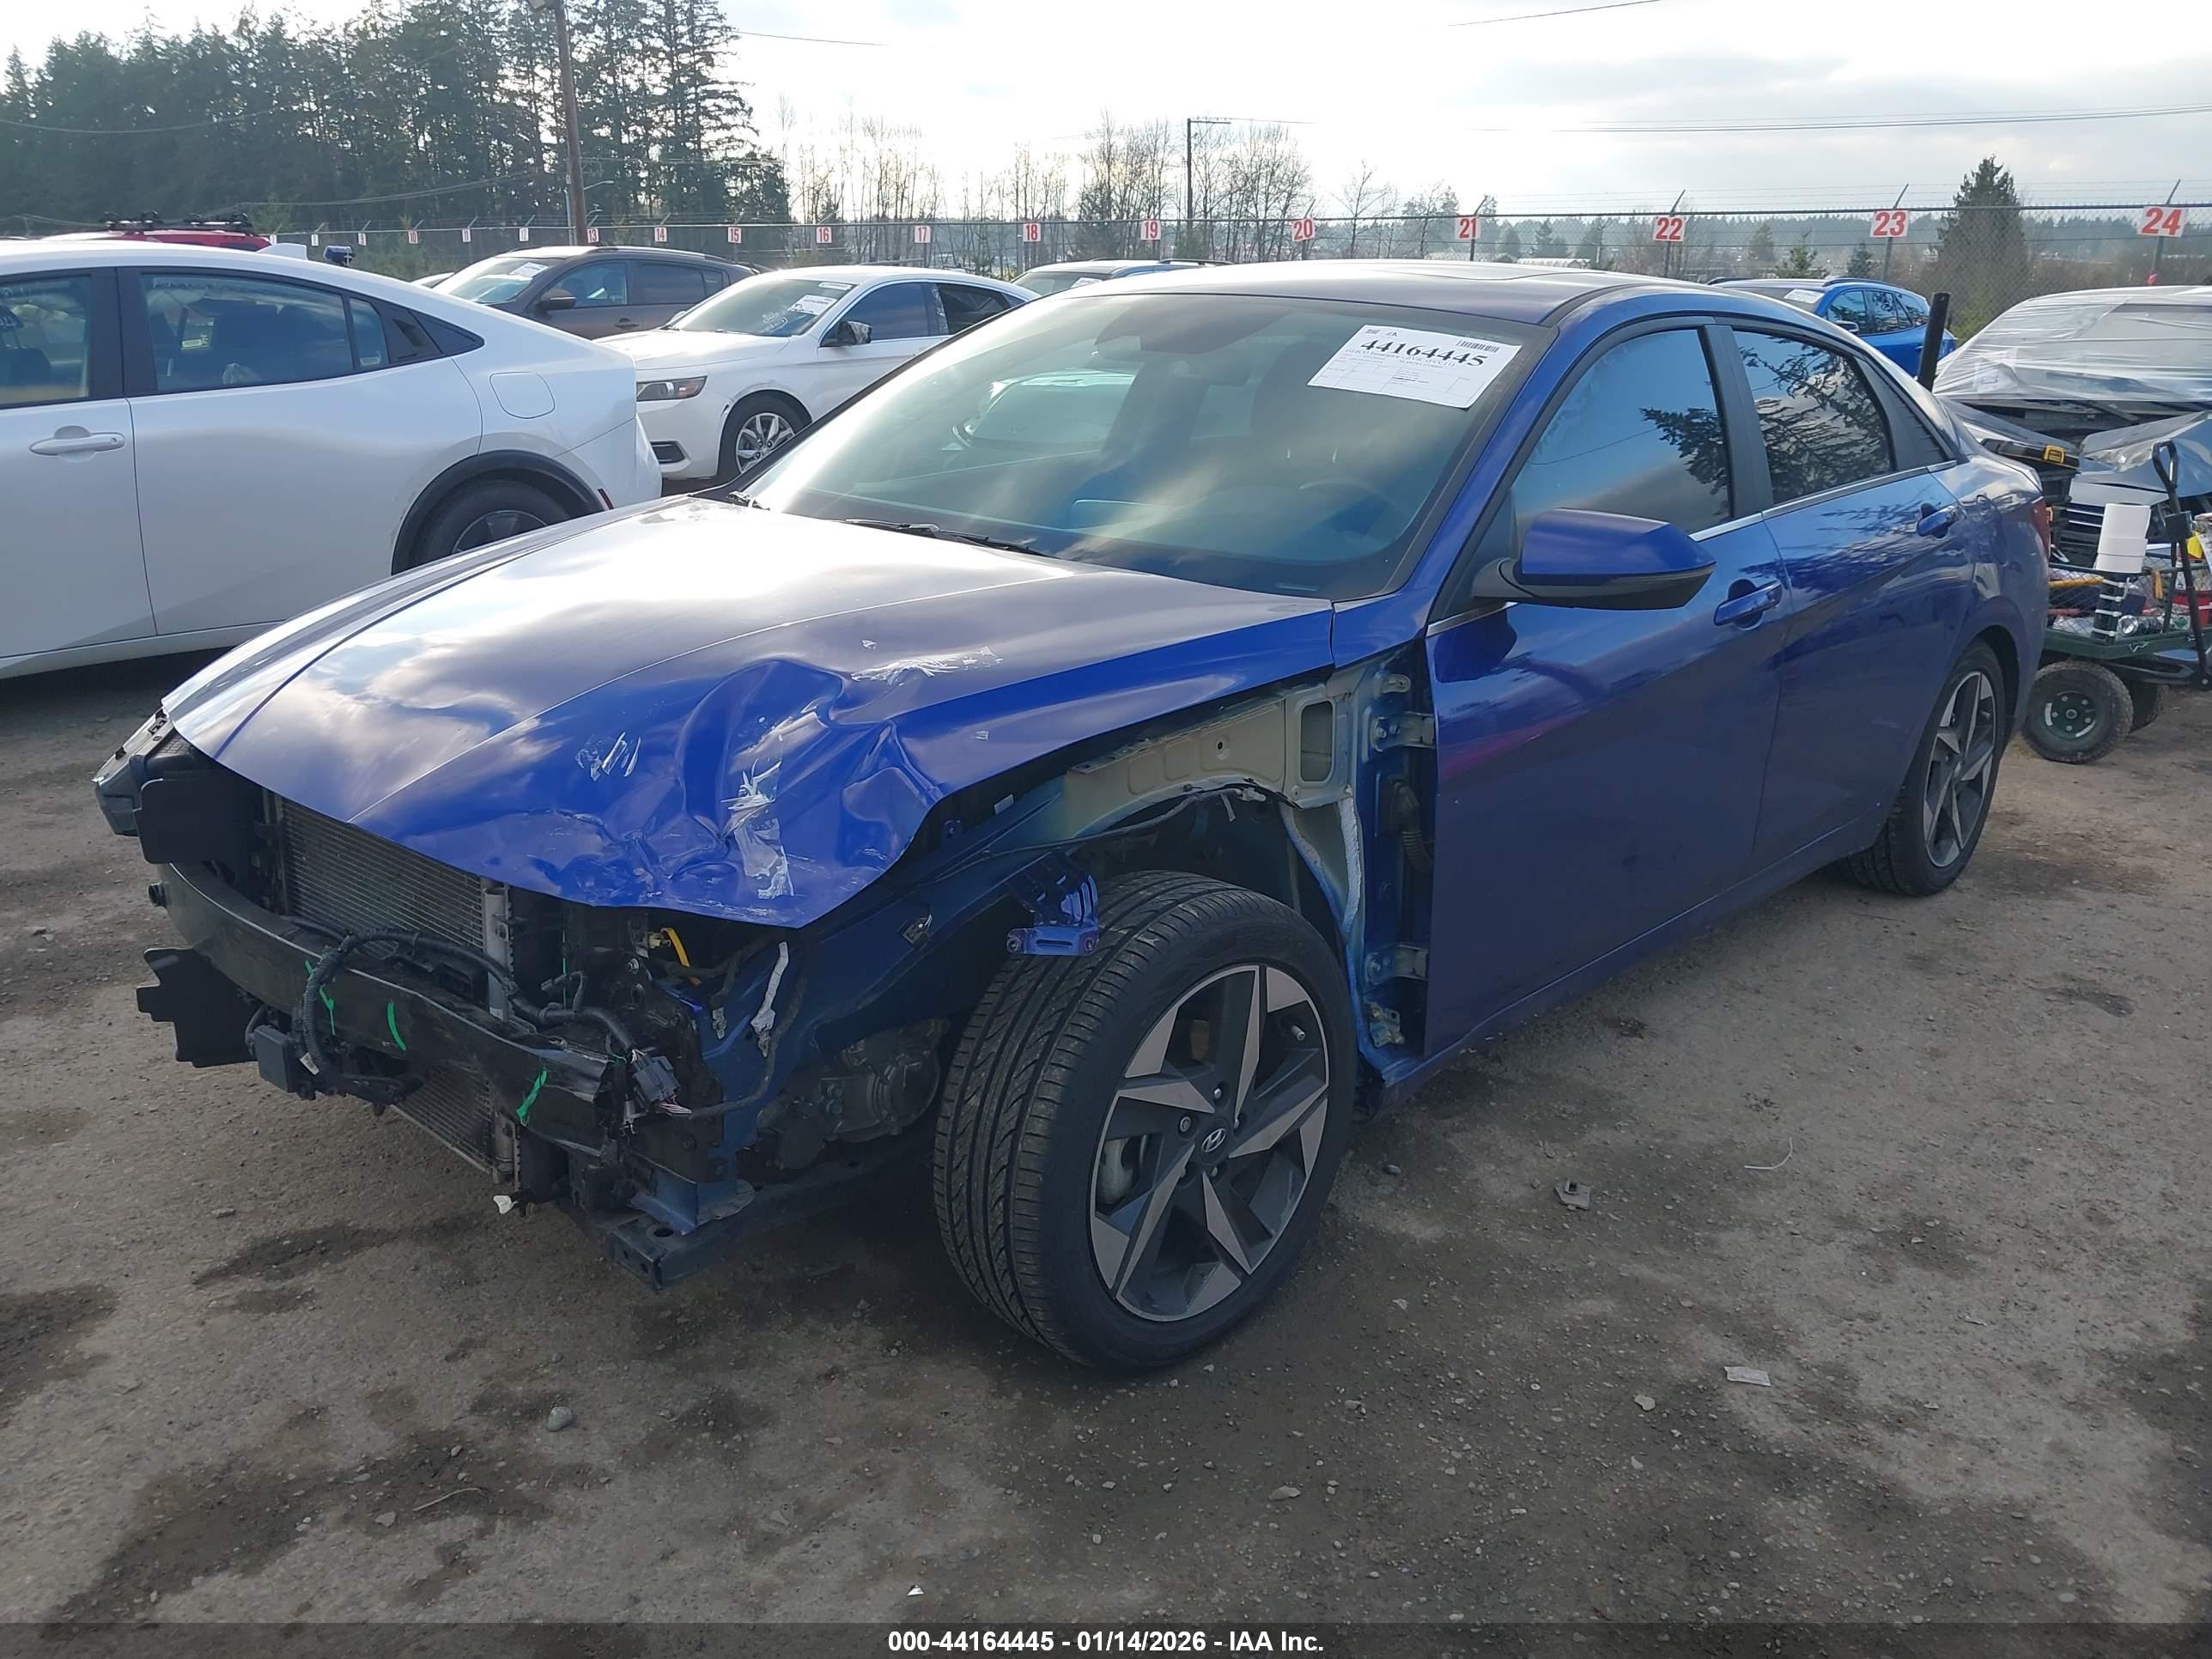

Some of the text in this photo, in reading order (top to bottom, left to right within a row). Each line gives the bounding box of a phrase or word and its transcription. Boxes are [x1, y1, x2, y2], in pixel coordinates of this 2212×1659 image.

[1873, 211, 1906, 237] 23
[2142, 208, 2182, 234] 24
[464, 229, 470, 240] 11
[589, 229, 597, 241] 13
[656, 228, 665, 240] 14
[729, 230, 739, 242] 15
[819, 228, 830, 242] 16
[918, 228, 928, 242] 17
[1026, 225, 1039, 240] 18
[1143, 221, 1158, 238] 19
[1294, 220, 1312, 240] 20
[1459, 219, 1476, 239] 21
[1656, 218, 1682, 240] 22
[410, 232, 416, 242] 10
[1361, 339, 1487, 366] 44164445
